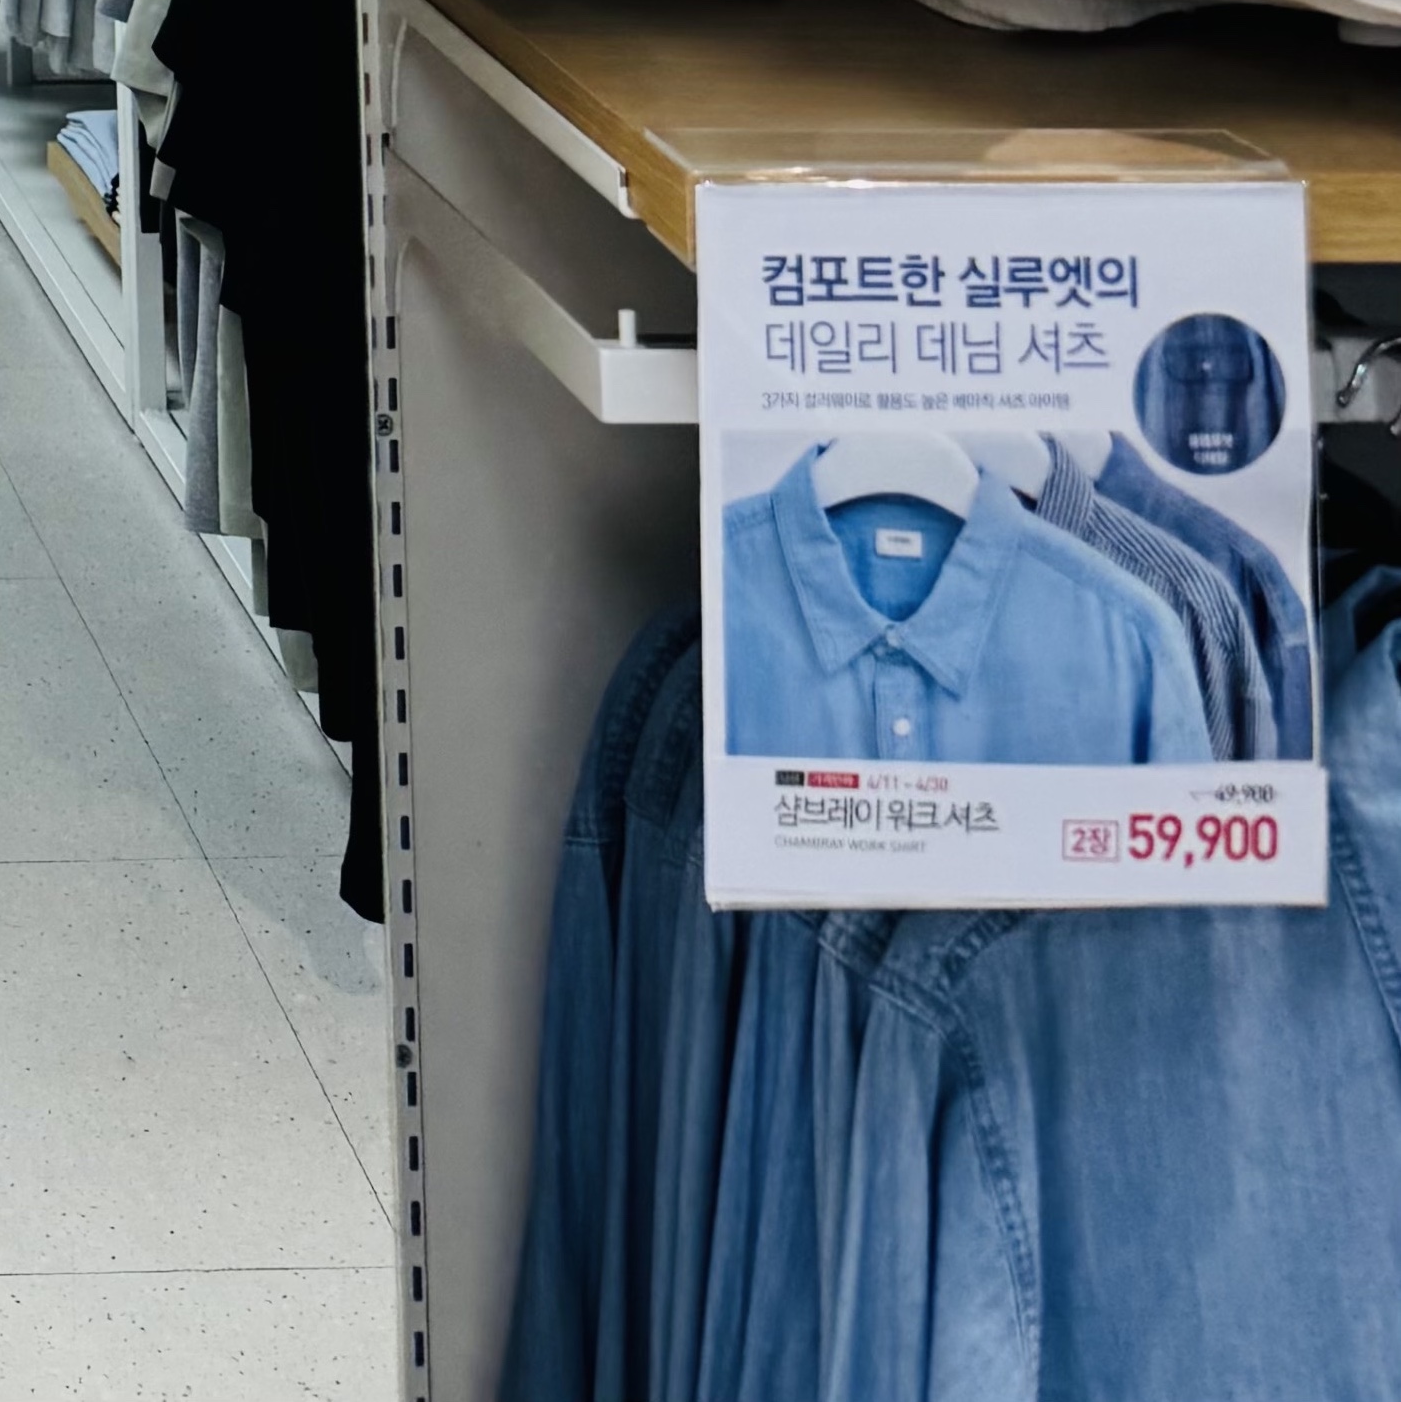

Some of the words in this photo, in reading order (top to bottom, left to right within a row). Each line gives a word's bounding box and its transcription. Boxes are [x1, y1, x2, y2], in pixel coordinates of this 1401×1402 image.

[761, 253, 946, 309] 컴포트한
[958, 254, 1139, 309] 실루엣의
[765, 319, 899, 375] 데일리
[915, 319, 1003, 375] 데님
[1018, 321, 1111, 375] 셔츠
[867, 775, 899, 791] 4/11
[915, 776, 949, 792] 4/30
[774, 793, 881, 832] 샴브레이
[886, 798, 942, 832] 워크
[943, 801, 1000, 833] 셔츠
[1070, 827, 1113, 855] 2장
[1128, 814, 1279, 869] 59,900
